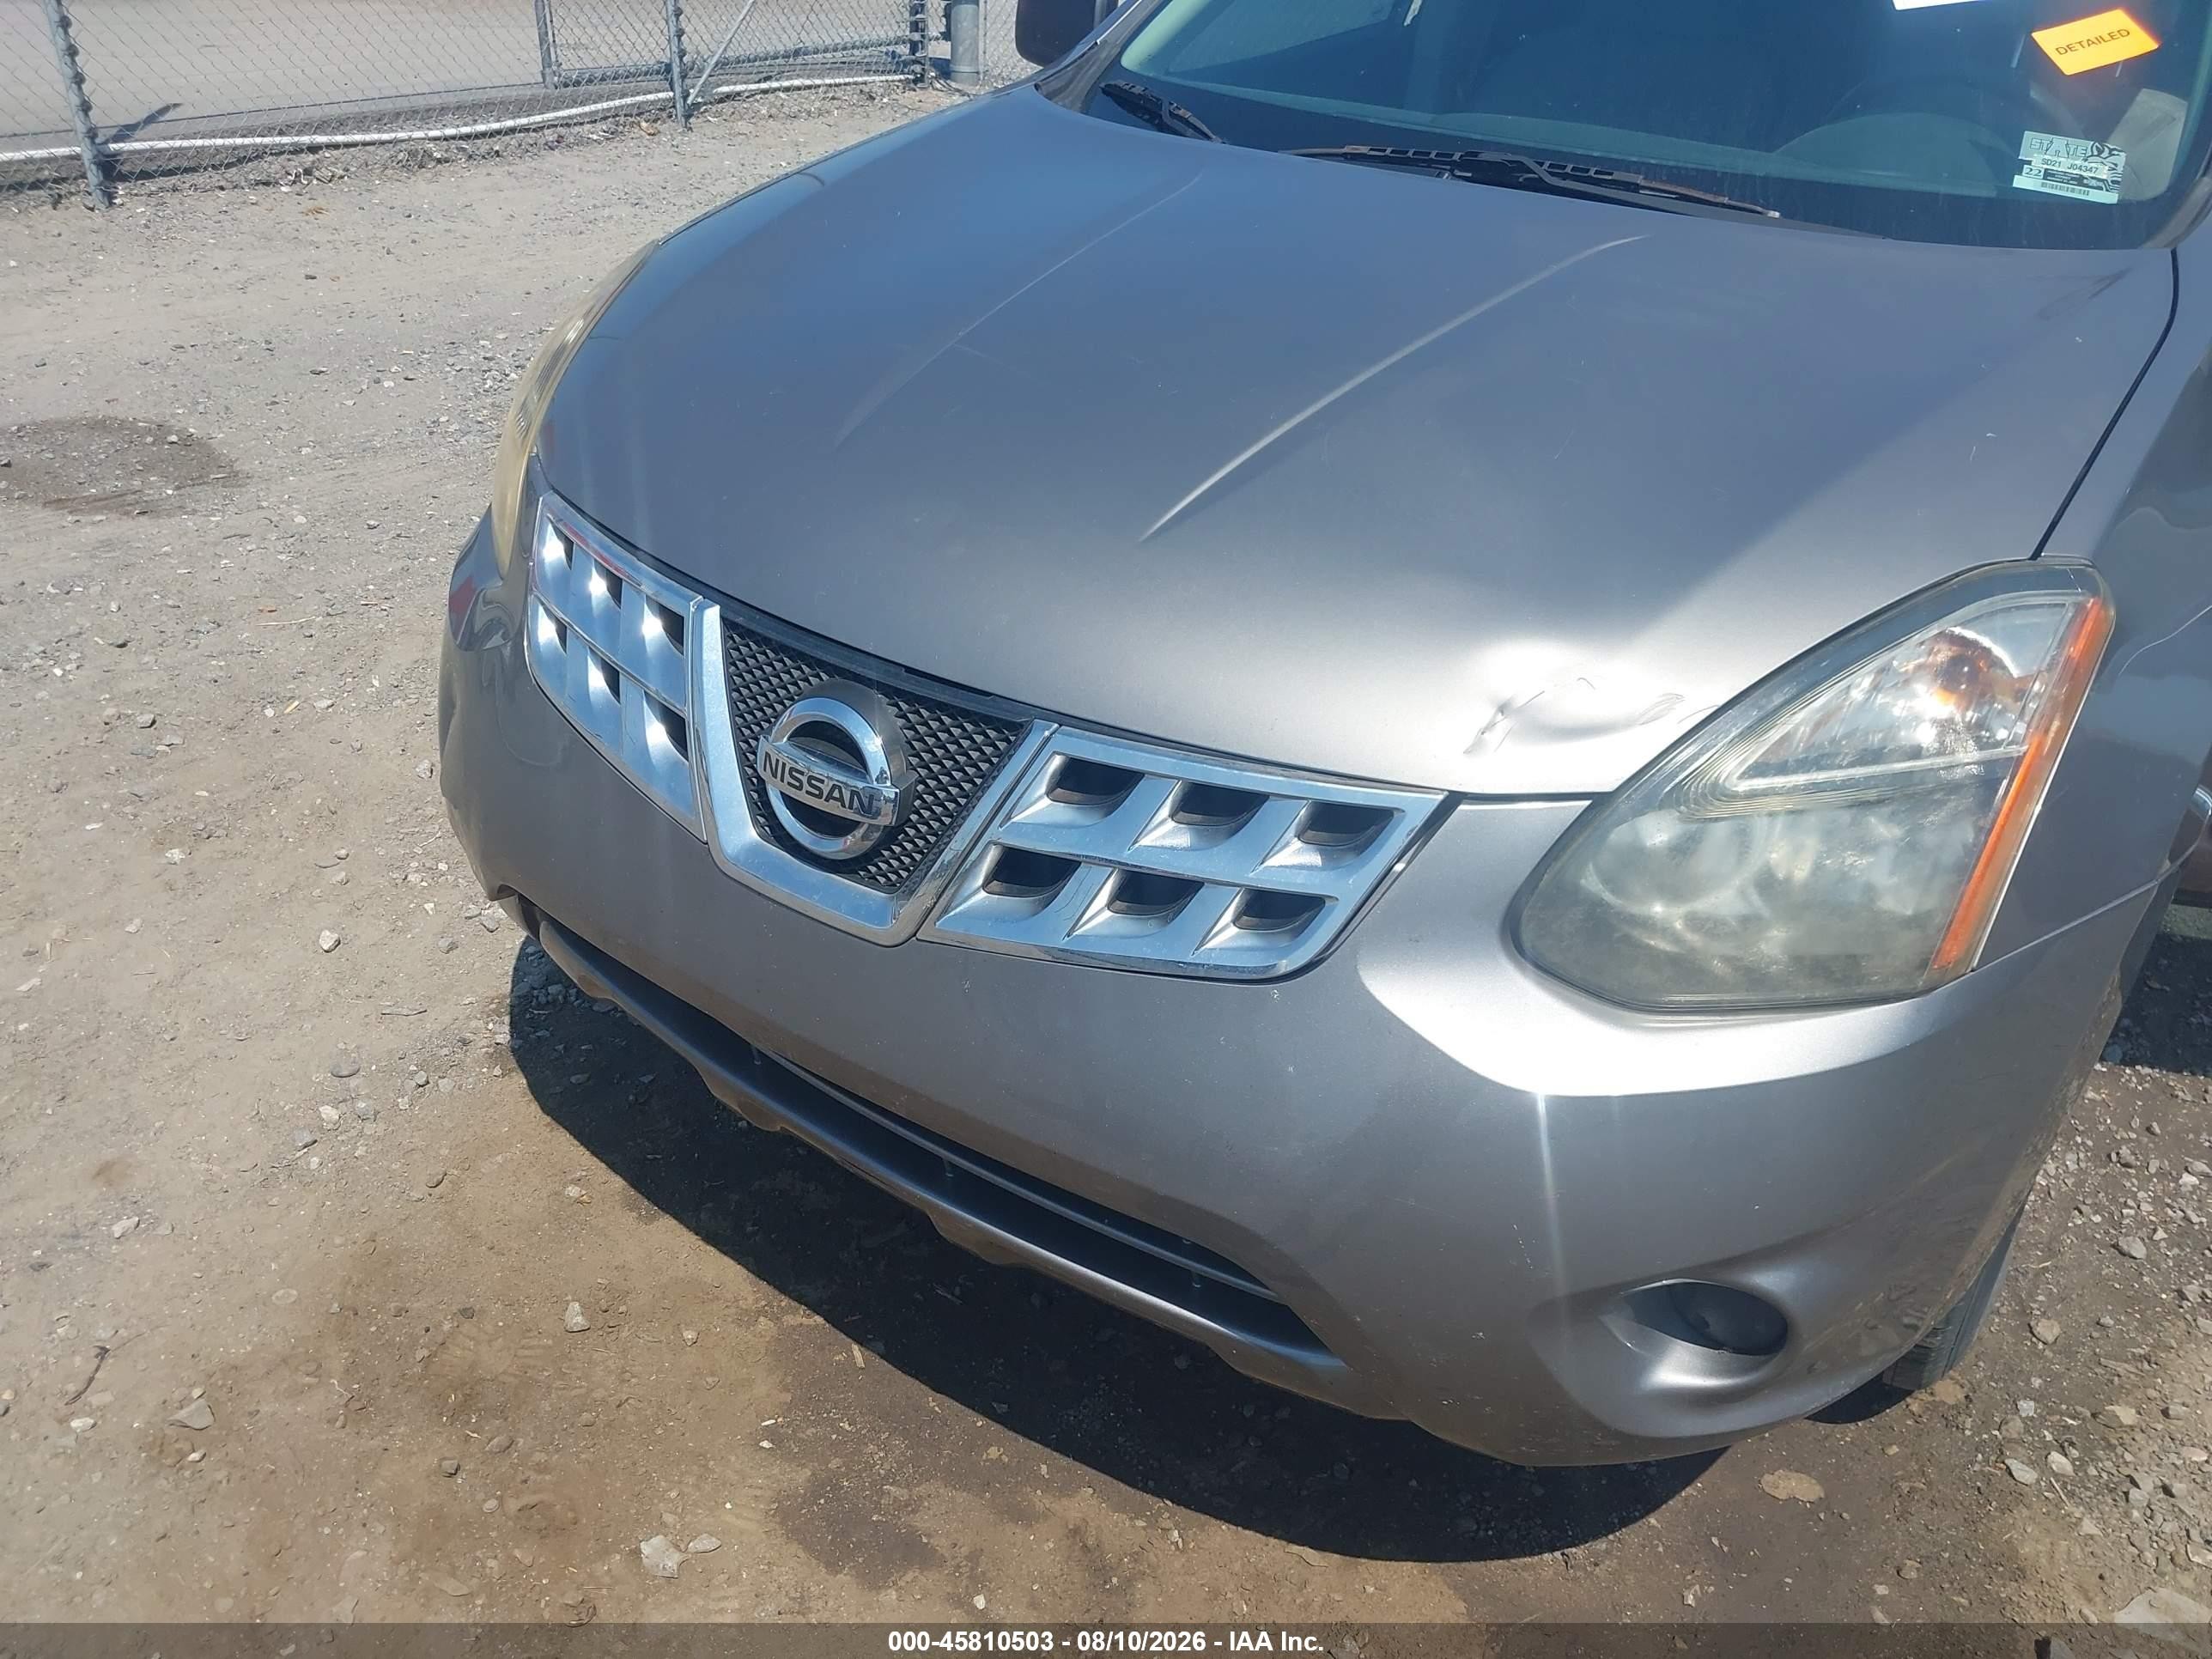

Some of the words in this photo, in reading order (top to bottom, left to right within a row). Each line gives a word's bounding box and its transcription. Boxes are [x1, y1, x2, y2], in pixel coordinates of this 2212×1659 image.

[2055, 28, 2130, 55] DETAILED
[2030, 137, 2087, 158] STATE
[2024, 167, 2042, 177] 22
[2041, 158, 2062, 168] SD21
[763, 752, 875, 817] NISSAN
